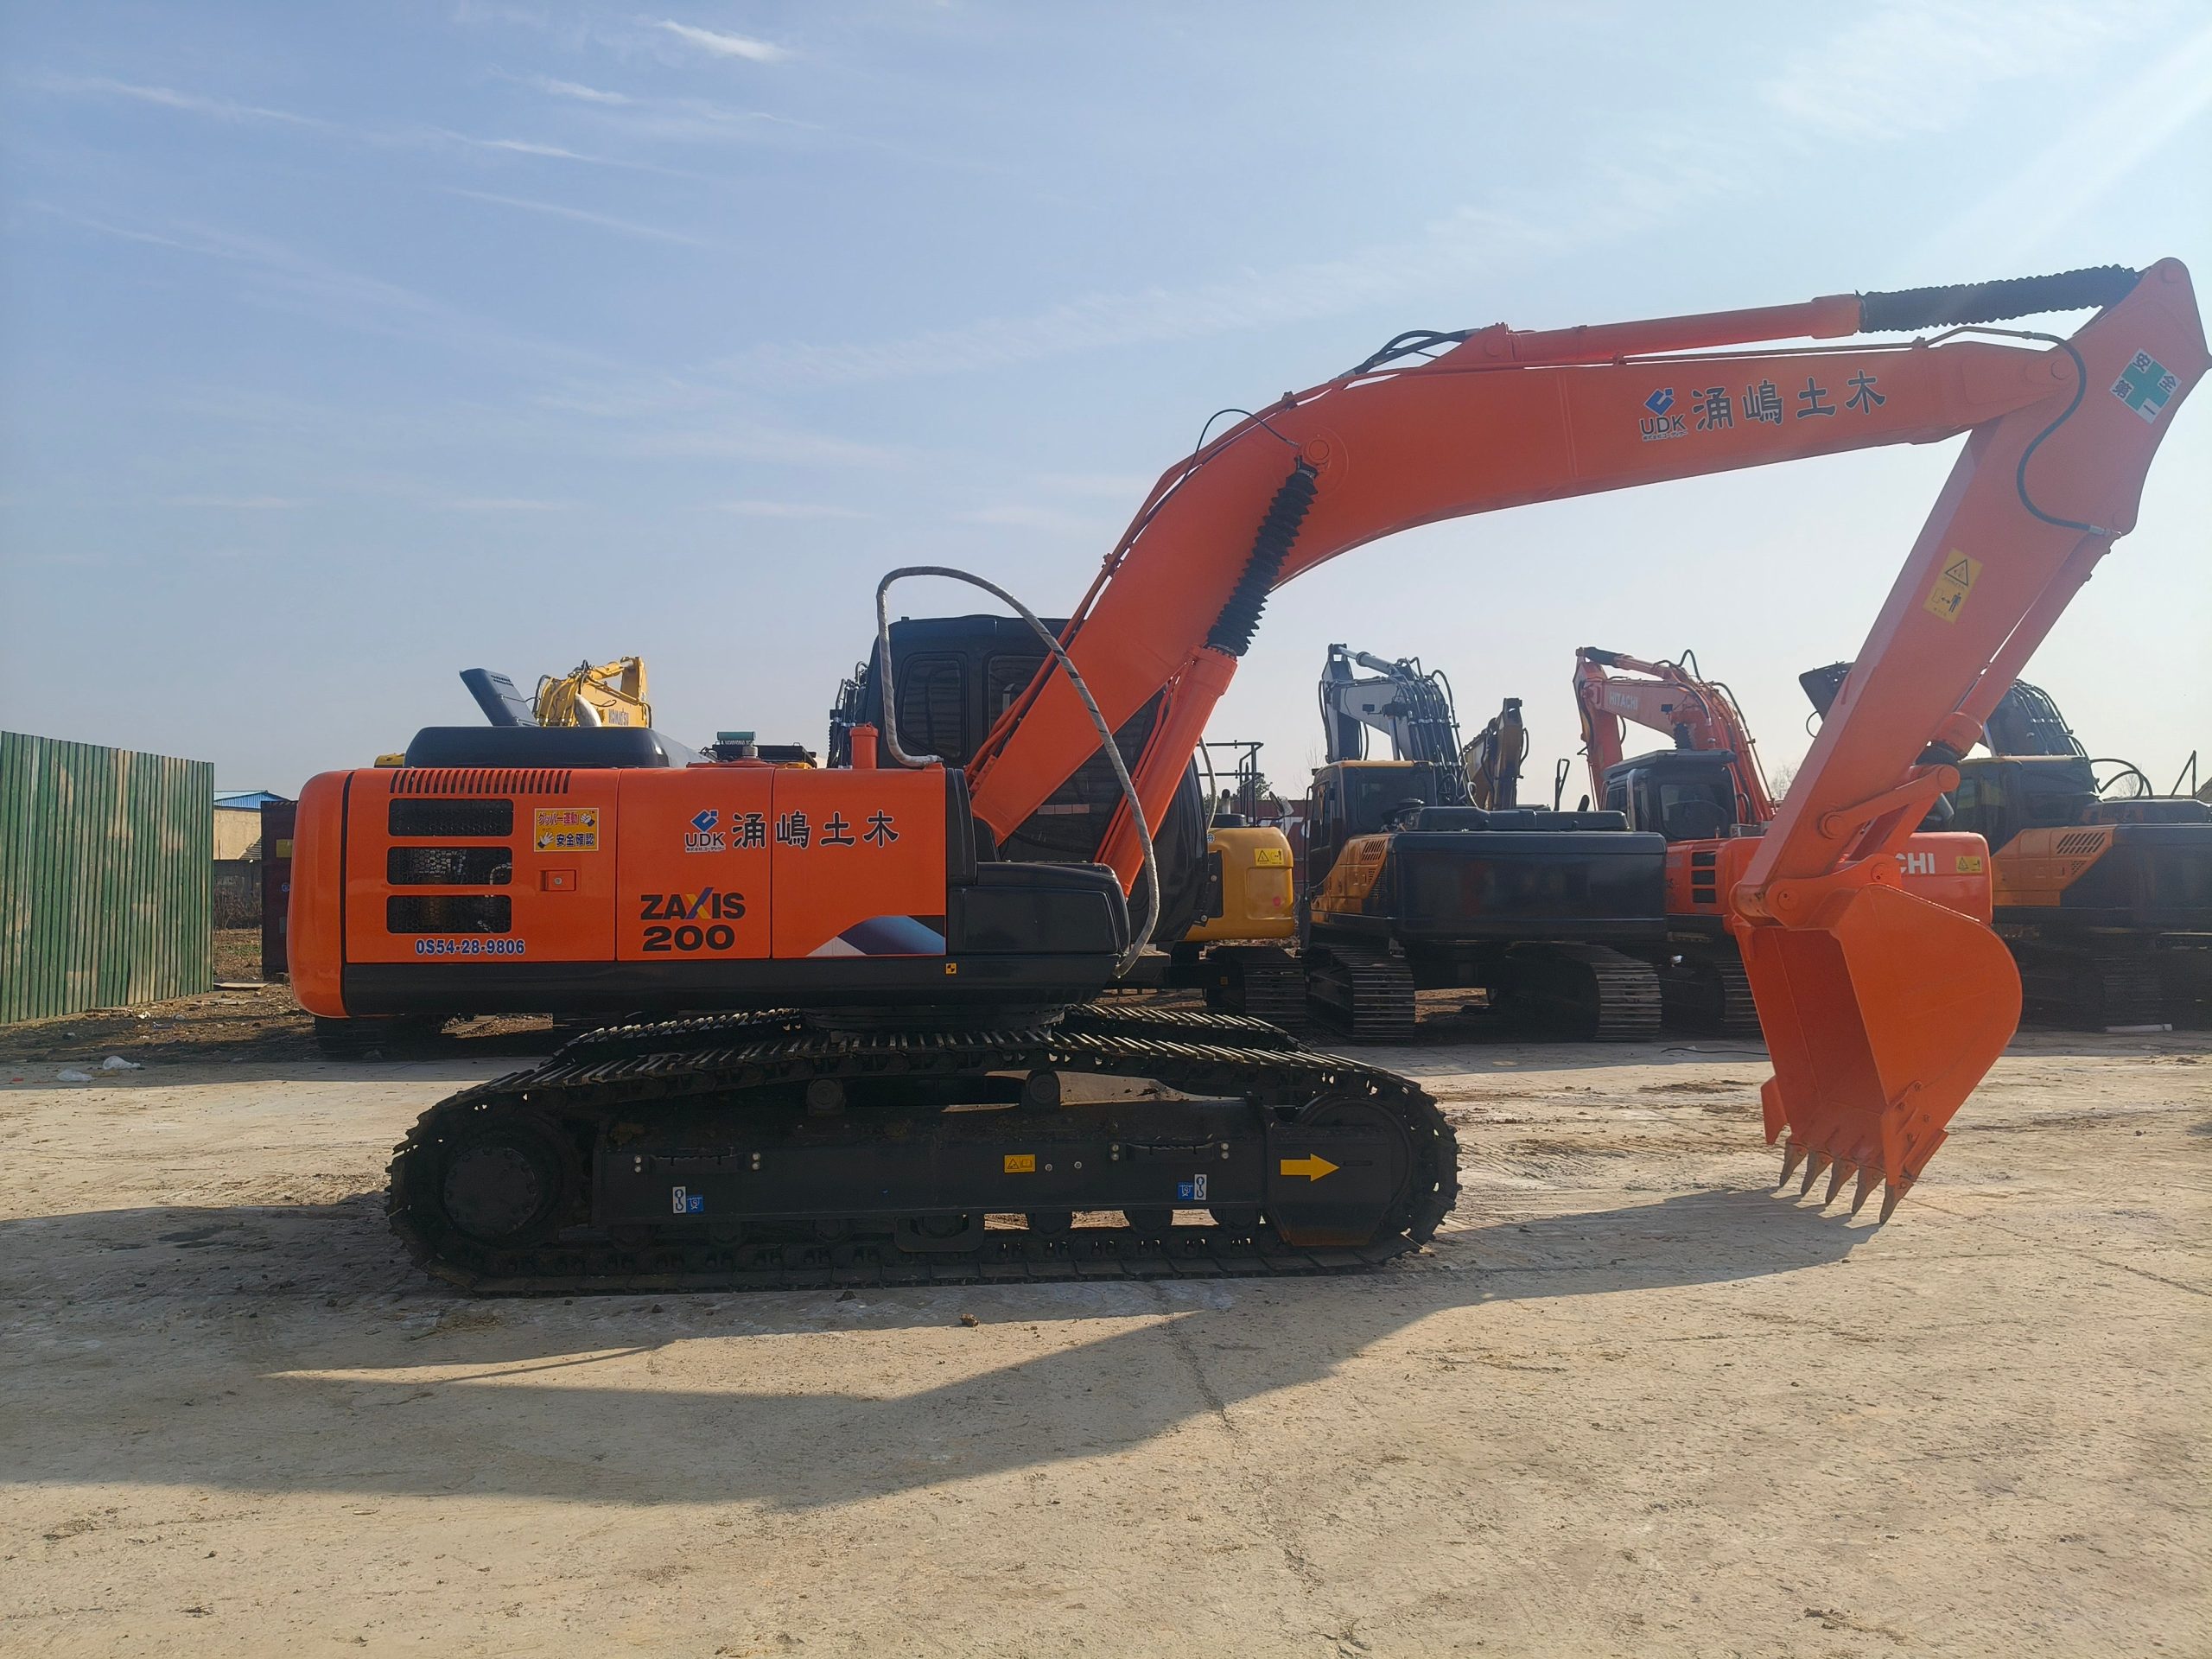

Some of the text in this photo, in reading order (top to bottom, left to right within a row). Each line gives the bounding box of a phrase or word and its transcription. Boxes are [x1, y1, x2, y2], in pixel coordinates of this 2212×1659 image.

[1640, 414, 1687, 435] UDK
[1609, 690, 1638, 710] HITACHI
[685, 832, 726, 847] UDK
[640, 887, 747, 920] ZAXIS
[642, 924, 735, 952] 200
